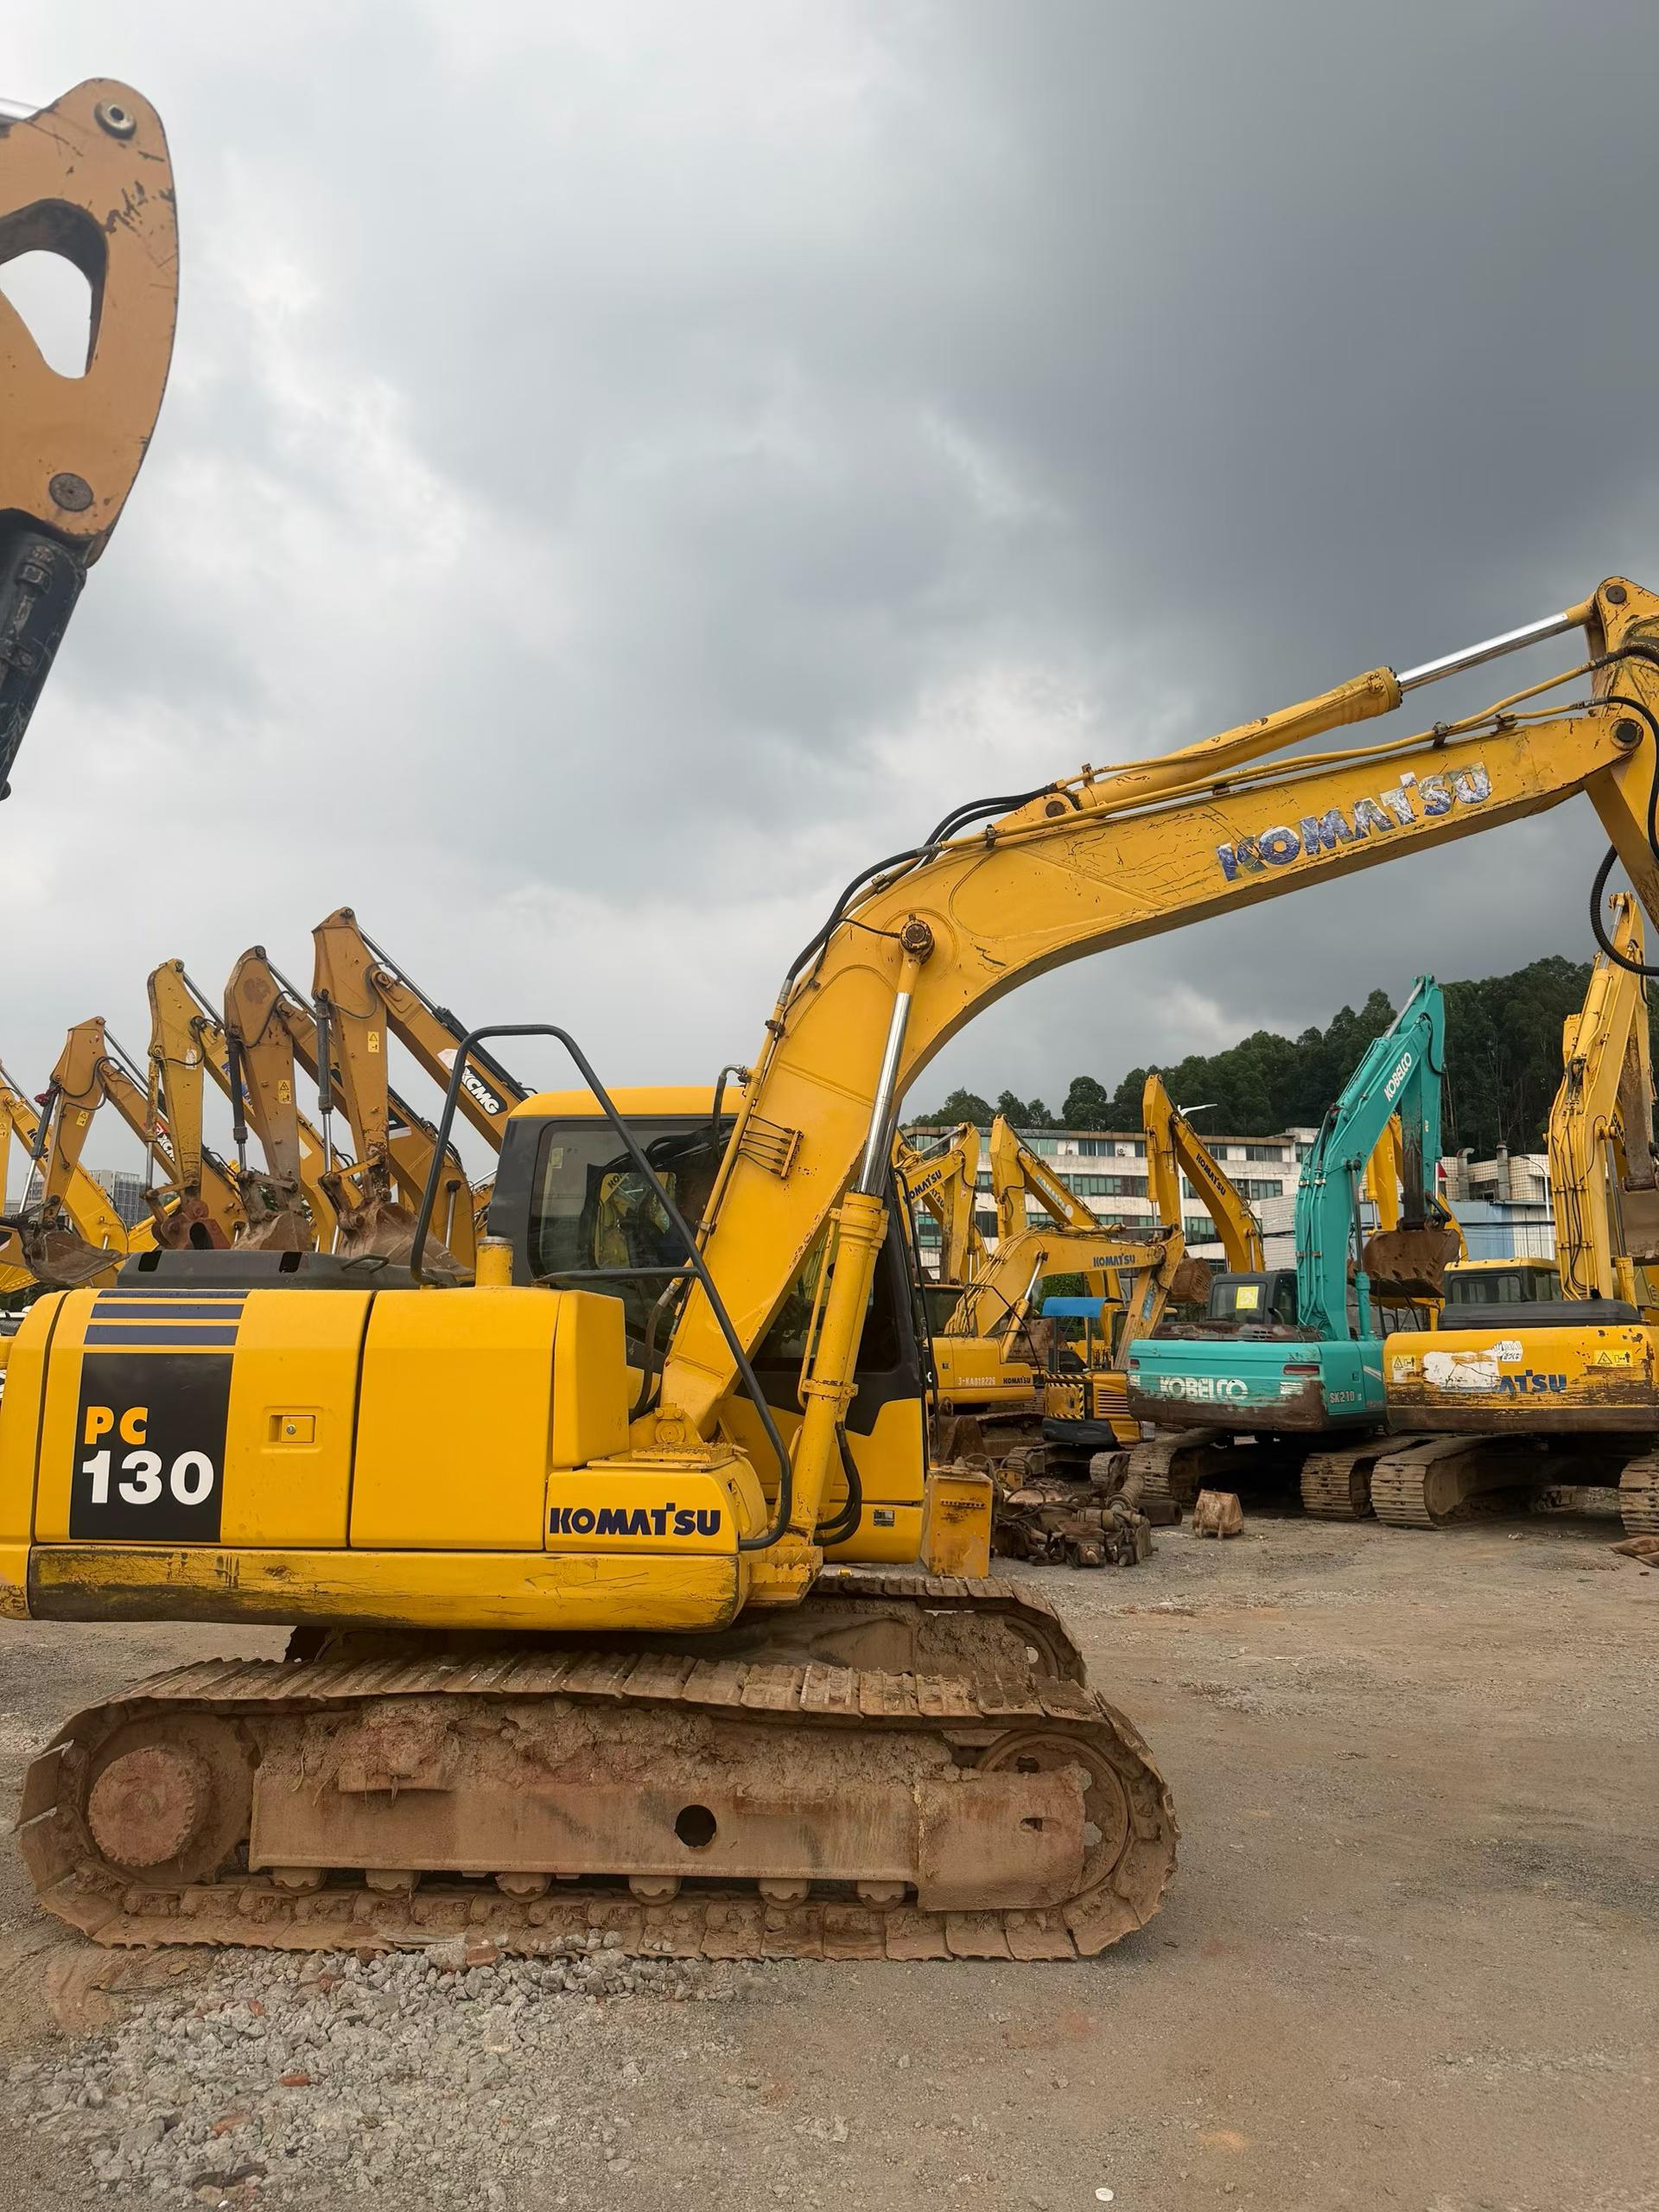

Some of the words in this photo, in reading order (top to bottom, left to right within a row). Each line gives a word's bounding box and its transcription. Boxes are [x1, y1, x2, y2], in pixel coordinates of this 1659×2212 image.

[1216, 761, 1493, 882] KOMATSU
[1384, 1052, 1412, 1102] KOBELCO
[156, 1133, 175, 1162] XCM
[1196, 1154, 1226, 1196] KOMATSU
[1093, 1254, 1135, 1268] KOMATSU
[1003, 1376, 1031, 1384] KOMATSU
[1160, 1376, 1249, 1400] KOBELCO
[1329, 1390, 1356, 1403] SK210
[84, 1406, 149, 1446] PC
[82, 1450, 214, 1506] 130
[549, 1502, 721, 1536] KOMATSU
